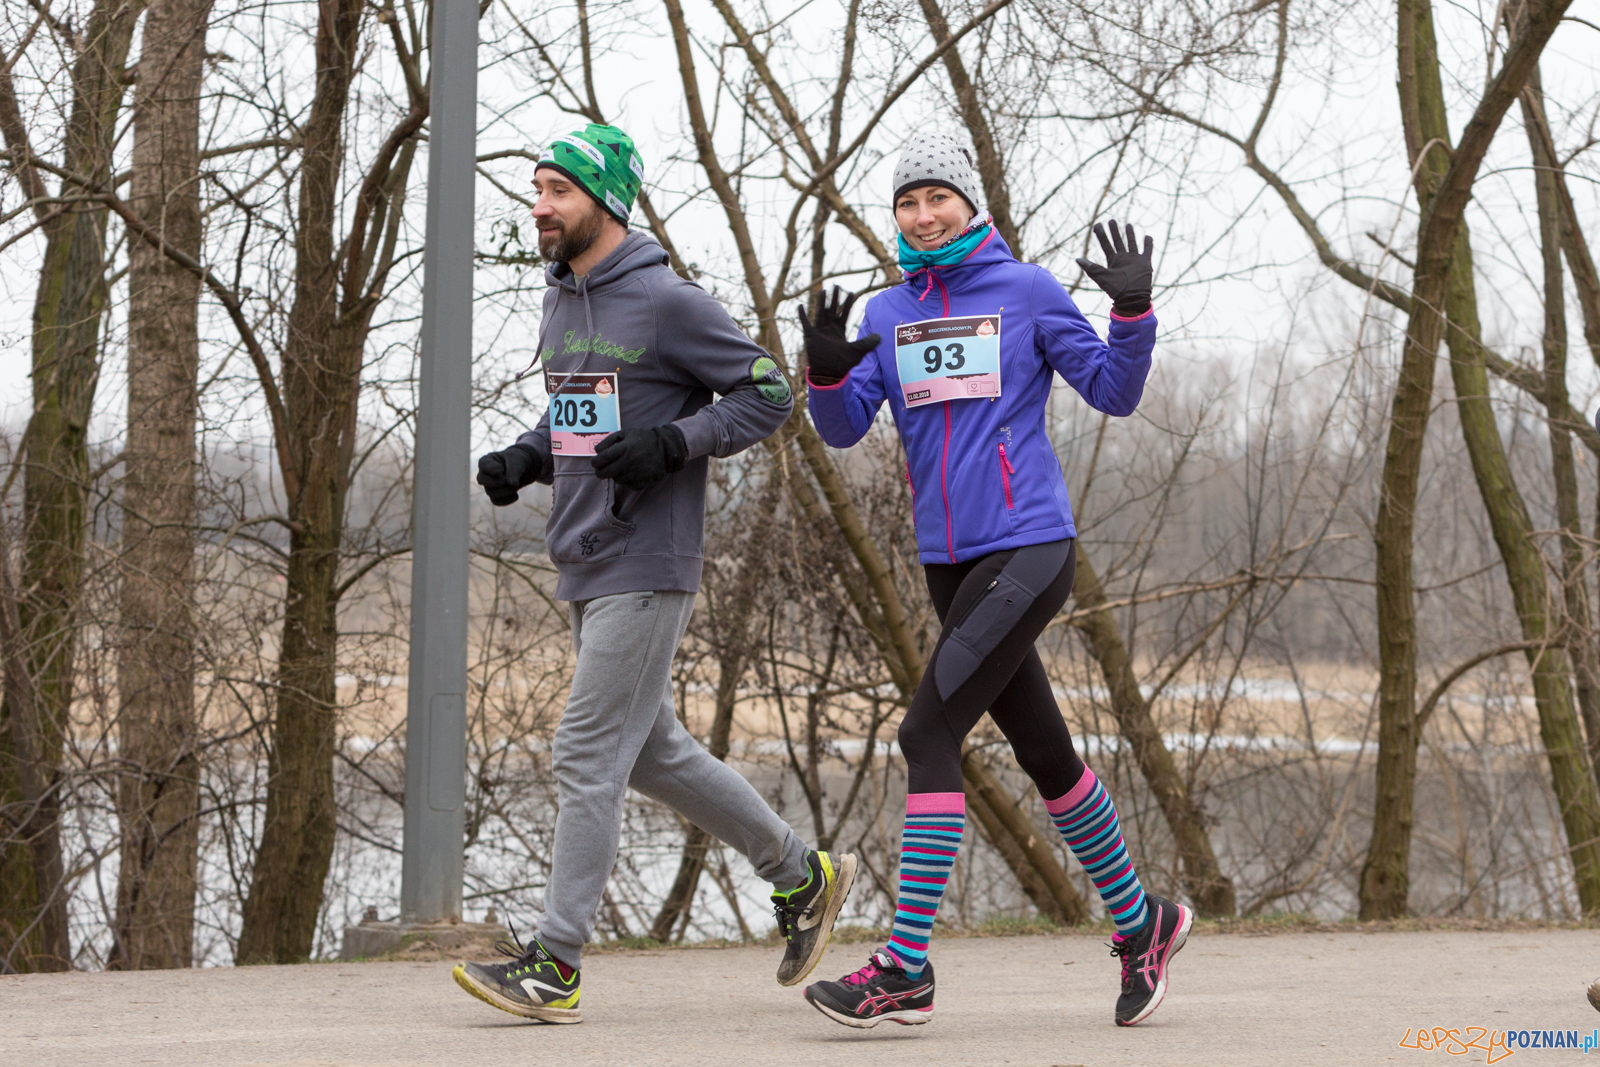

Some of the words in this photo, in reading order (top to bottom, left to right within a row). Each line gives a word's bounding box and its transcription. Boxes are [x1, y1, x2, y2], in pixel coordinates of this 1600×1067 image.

[923, 342, 966, 374] 93
[554, 399, 598, 427] 203
[581, 544, 594, 556] 75
